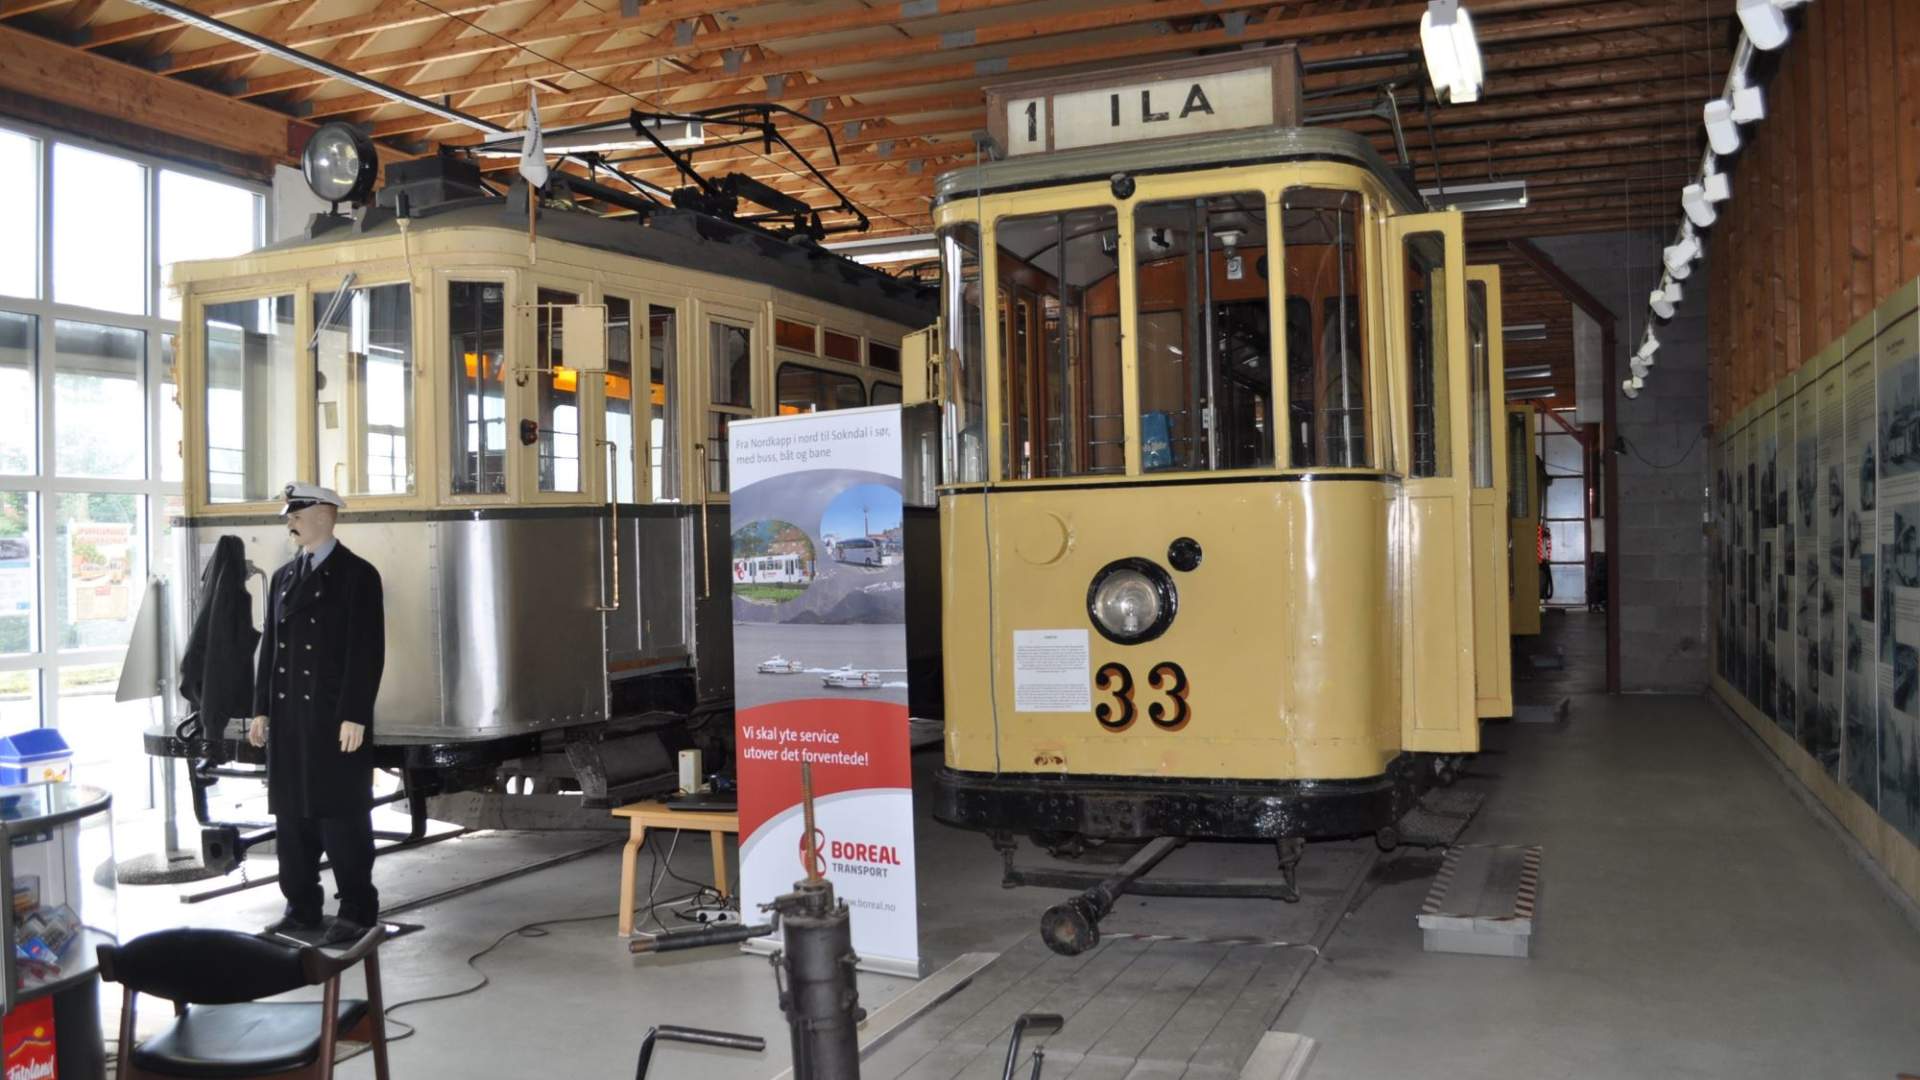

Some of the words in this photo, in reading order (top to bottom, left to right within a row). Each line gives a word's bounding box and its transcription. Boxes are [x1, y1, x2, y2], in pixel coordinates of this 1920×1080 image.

[1024, 101, 1037, 142] 1
[1110, 83, 1215, 127] ILA
[735, 439, 749, 449] Fra
[750, 435, 792, 449] Nordkapp
[798, 431, 819, 444] nord
[820, 430, 830, 442] til
[831, 426, 868, 440] Sokndal
[874, 427, 891, 438] sør,
[736, 454, 755, 465] med
[756, 452, 778, 464] buss,
[779, 449, 794, 462] båt
[795, 451, 808, 463] og
[808, 448, 832, 459] bane
[1094, 661, 1192, 733] 33
[742, 726, 755, 739] Vi
[756, 726, 777, 740] skal
[778, 728, 798, 745] yte
[799, 729, 840, 744] service
[743, 746, 779, 761] utover
[780, 747, 800, 762] det
[801, 747, 869, 766] forventede!
[831, 840, 901, 865] BOREAL
[831, 863, 889, 878] TRANSPORT
